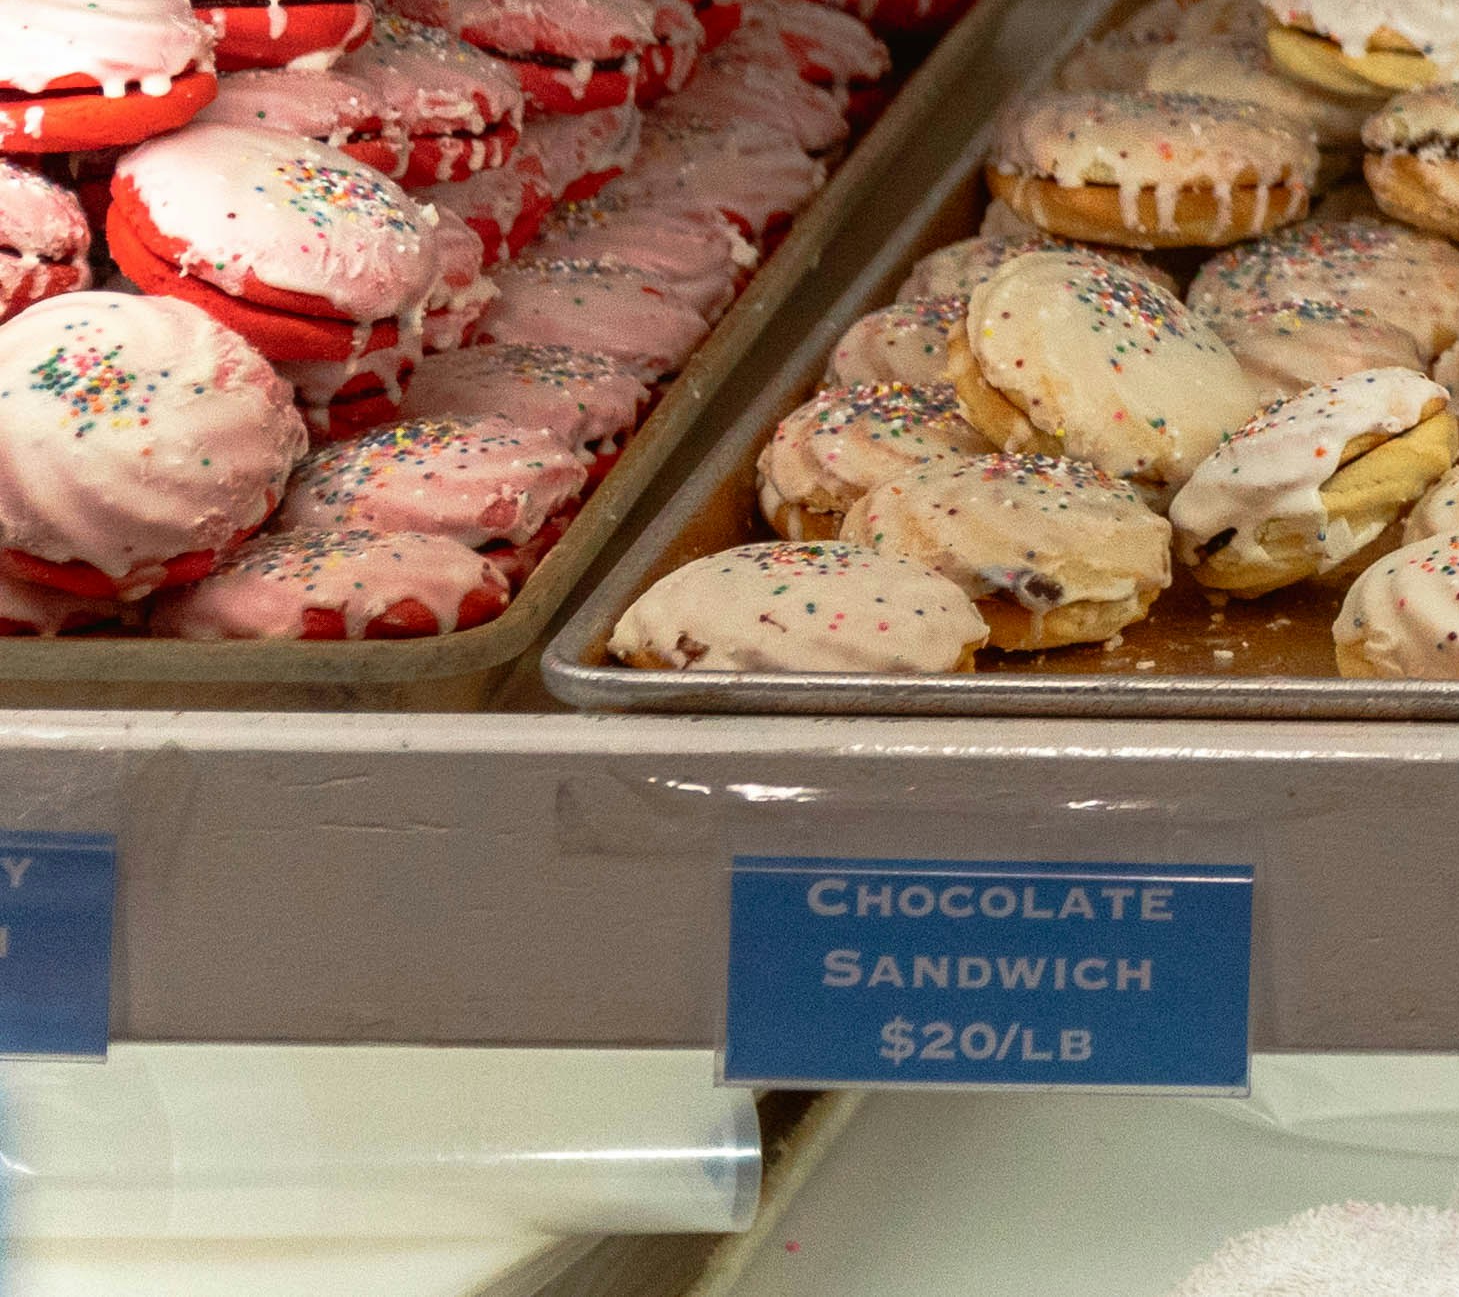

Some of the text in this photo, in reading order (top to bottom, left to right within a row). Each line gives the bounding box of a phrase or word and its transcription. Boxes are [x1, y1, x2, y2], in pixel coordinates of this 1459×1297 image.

[807, 877, 1174, 921] CHOCOLATE
[823, 949, 1153, 991] SANDWICH
[880, 1016, 1093, 1065] $20/LB
